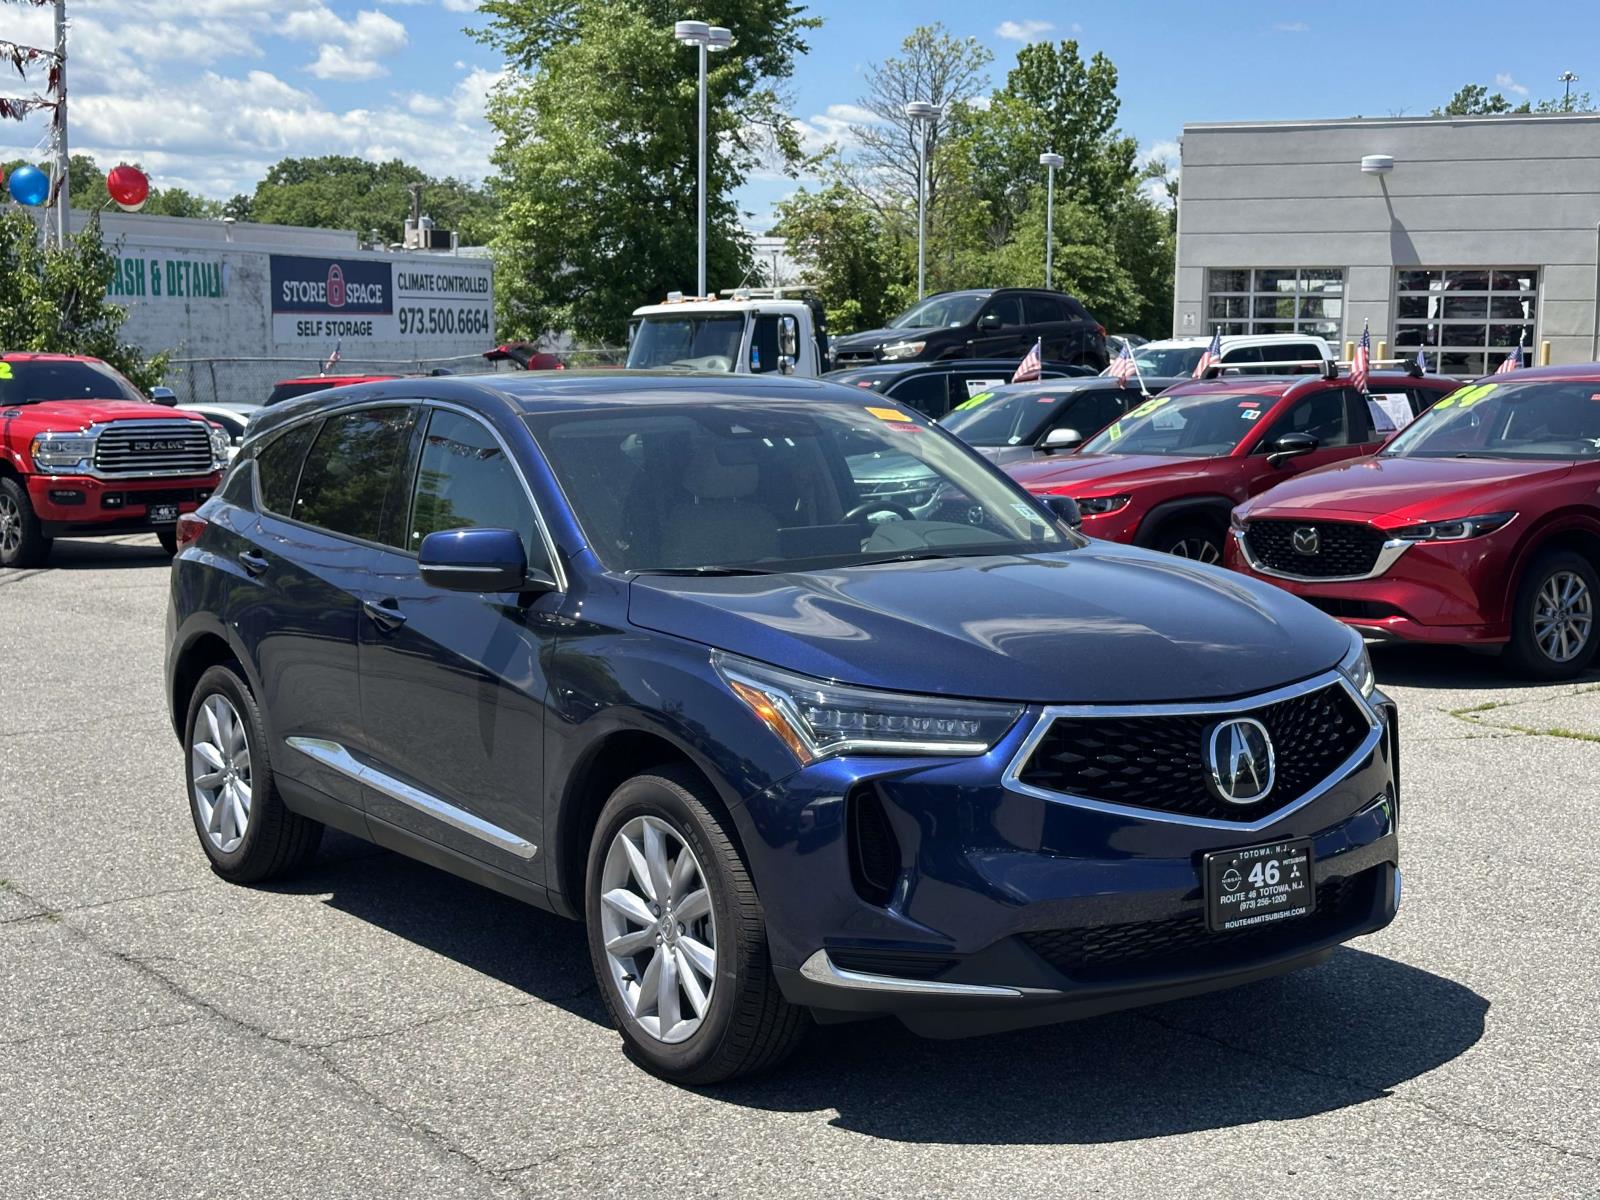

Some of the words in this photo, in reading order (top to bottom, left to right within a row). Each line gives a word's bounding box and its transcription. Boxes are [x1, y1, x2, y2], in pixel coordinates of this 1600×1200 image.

[150, 259, 162, 296] &
[398, 272, 435, 291] CLIMATE
[436, 274, 489, 294] CONTROLLED
[282, 280, 327, 303] STORE
[345, 283, 384, 304] SPACE
[297, 320, 323, 337] SELF
[325, 321, 373, 337] STORAGE
[399, 306, 489, 335] 973.500.6664
[1248, 860, 1280, 887] 46
[1220, 892, 1246, 904] ROUTE
[1248, 890, 1257, 899] 46
[1240, 901, 1256, 912] (973)
[1257, 894, 1287, 907] 256-1200
[1225, 907, 1306, 929] ROUTE46MITSUBISHI.COM
